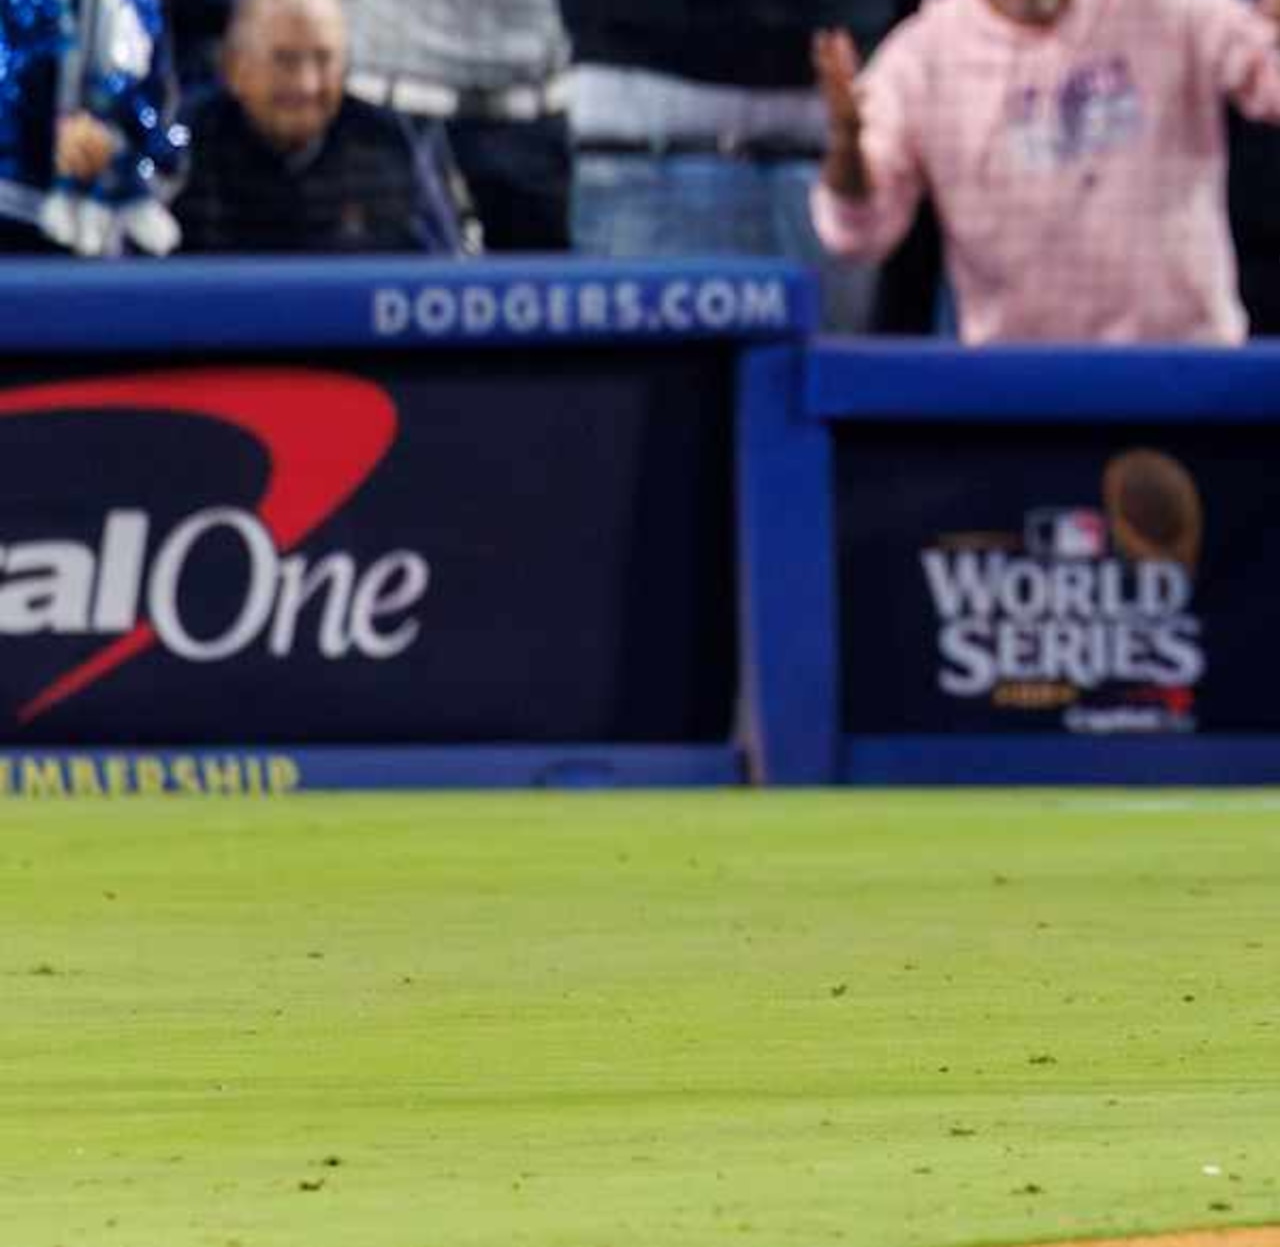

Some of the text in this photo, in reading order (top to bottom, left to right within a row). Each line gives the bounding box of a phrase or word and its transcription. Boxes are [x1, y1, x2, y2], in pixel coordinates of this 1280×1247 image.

[373, 279, 787, 335] DODGERS.COM
[921, 550, 1187, 621] WORLD
[938, 615, 1204, 696] SERIES
